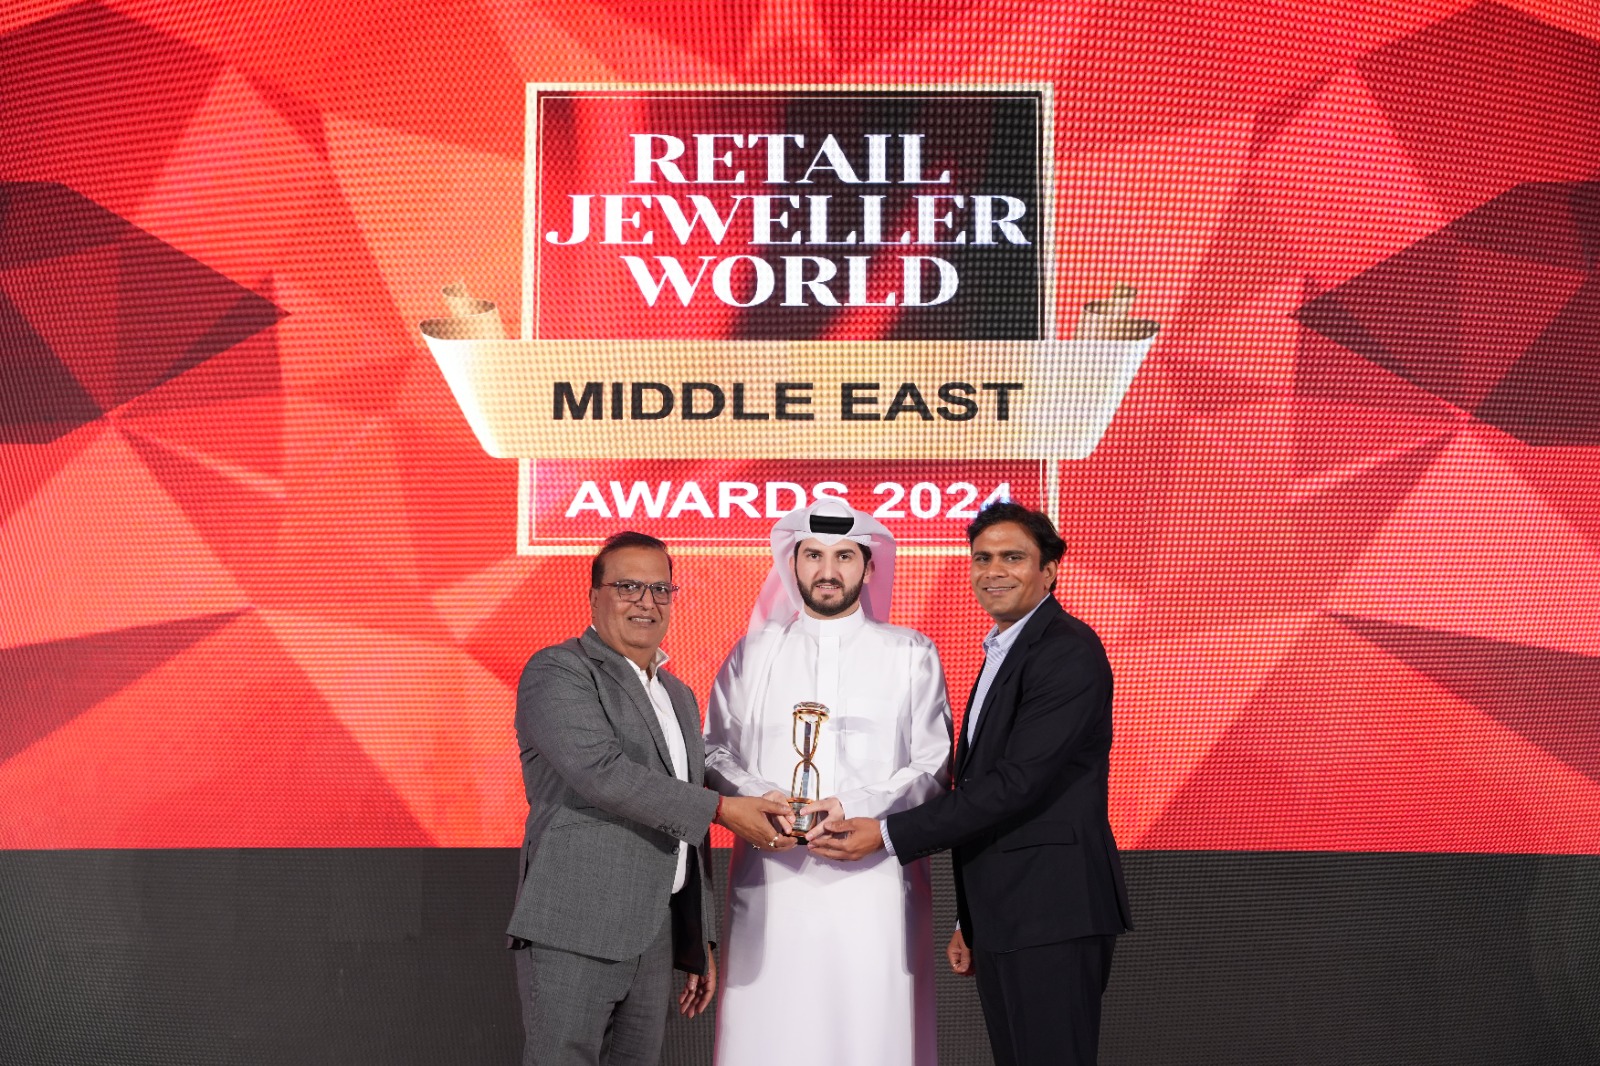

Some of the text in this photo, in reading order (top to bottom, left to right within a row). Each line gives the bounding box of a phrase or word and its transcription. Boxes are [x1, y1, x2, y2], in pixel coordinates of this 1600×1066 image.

[629, 133, 951, 184] RETAIL
[545, 194, 1031, 245] JEWELLER
[620, 255, 960, 307] WORLD
[552, 382, 1023, 421] MIDDLE EAST
